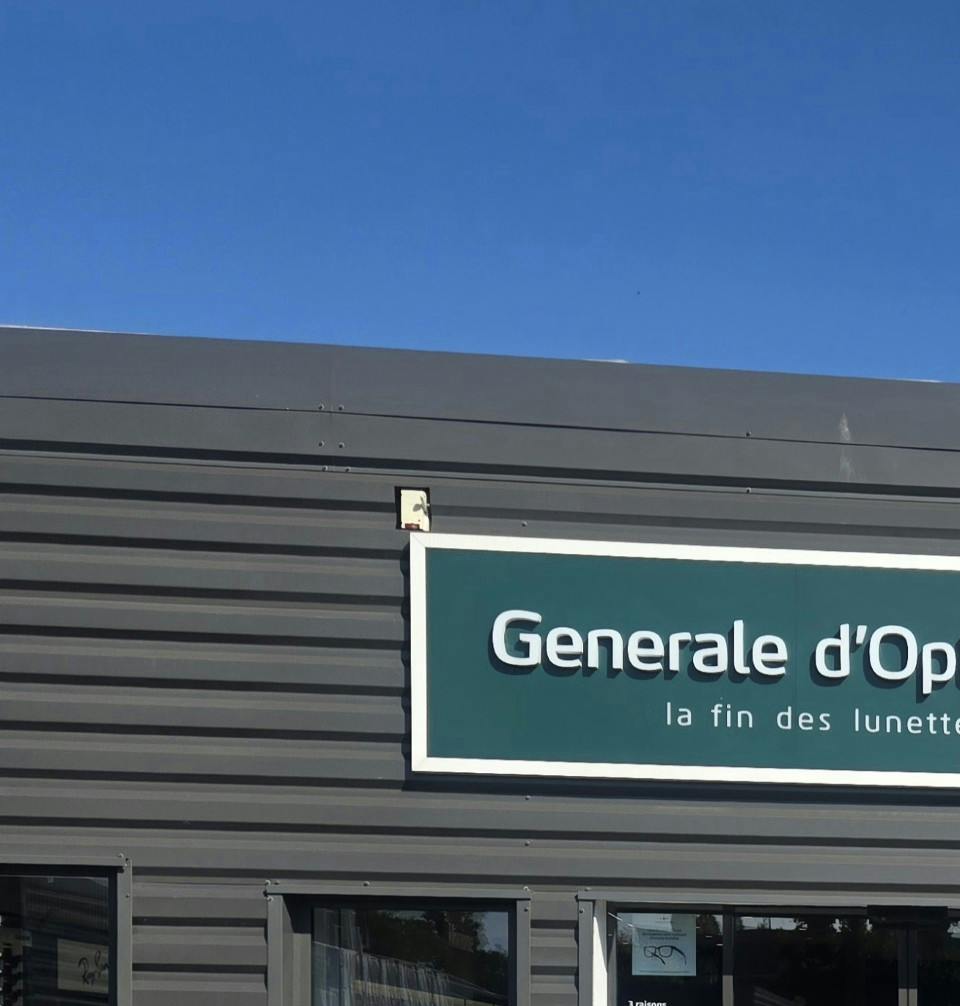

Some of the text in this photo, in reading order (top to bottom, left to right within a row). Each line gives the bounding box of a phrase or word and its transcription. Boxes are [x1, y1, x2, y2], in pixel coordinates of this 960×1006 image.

[491, 609, 788, 676] Generale
[666, 702, 692, 726] la
[711, 703, 753, 728] fin
[776, 706, 831, 731] des
